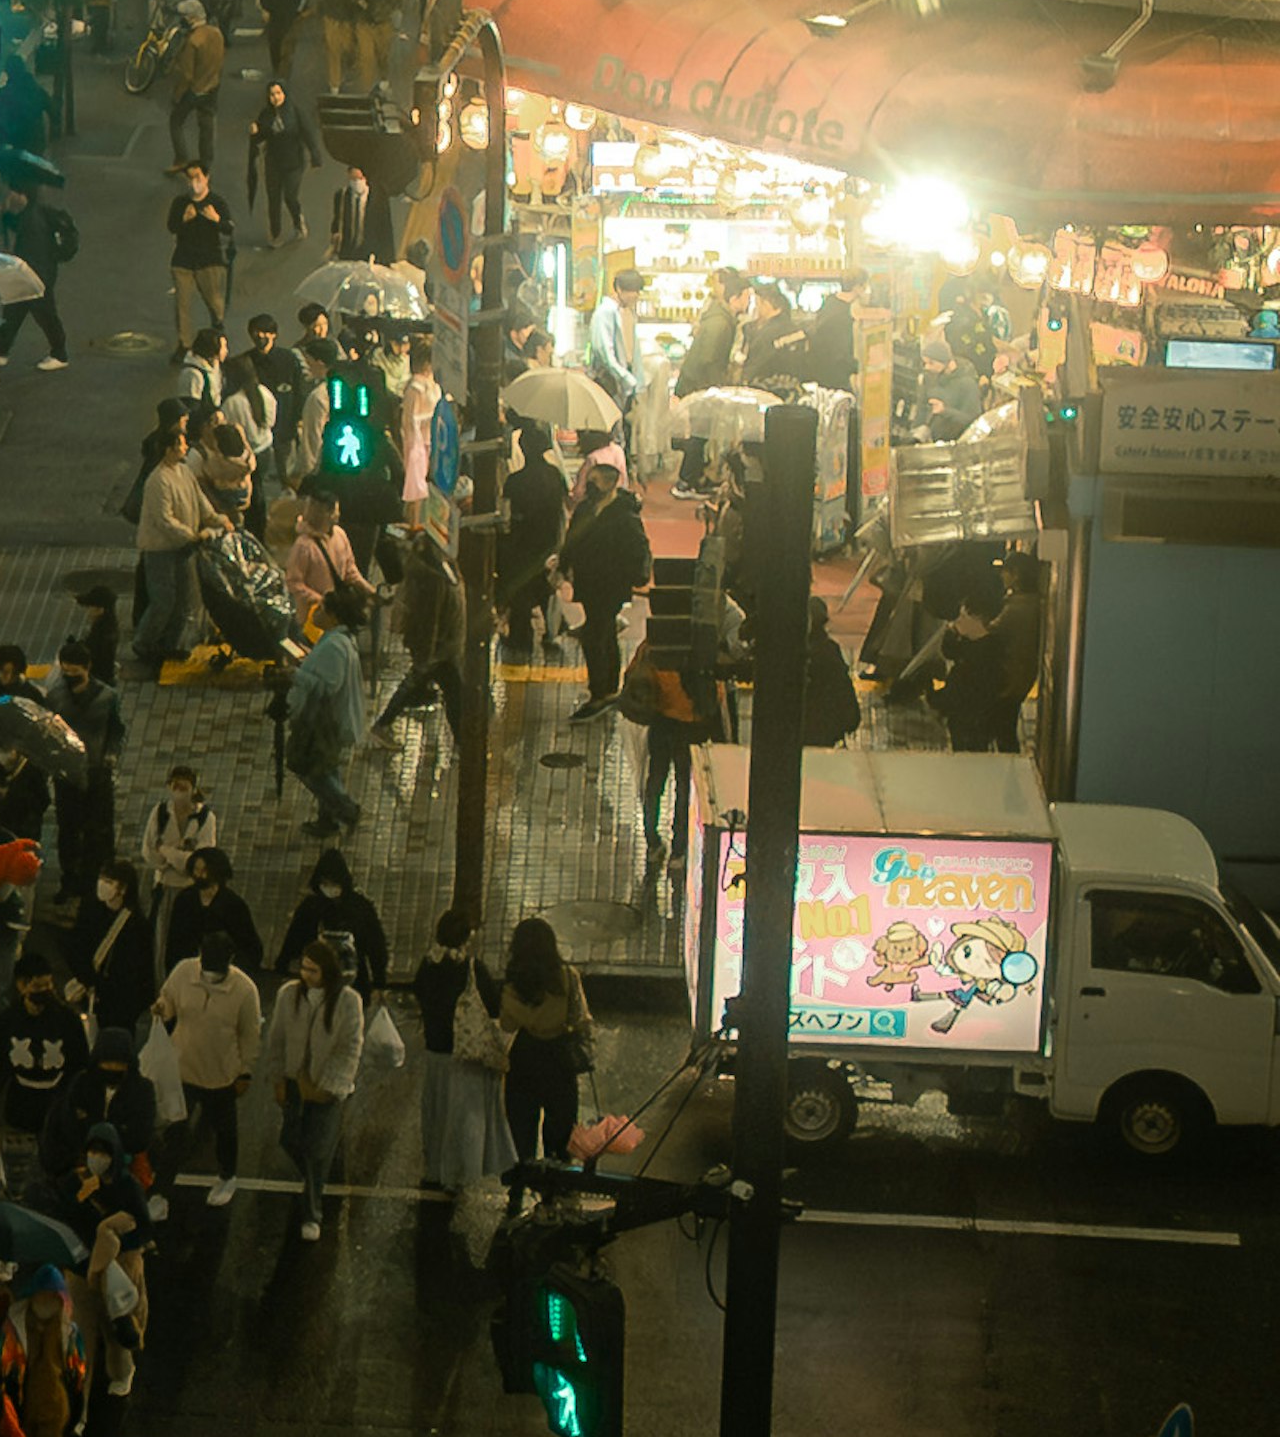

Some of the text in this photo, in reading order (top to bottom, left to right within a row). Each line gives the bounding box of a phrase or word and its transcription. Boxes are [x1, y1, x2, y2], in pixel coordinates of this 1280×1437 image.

[591, 55, 846, 157] Don Quijote
[1166, 274, 1225, 299] ALOHA
[886, 871, 1036, 912] Heaven
[799, 893, 872, 941] No.1
